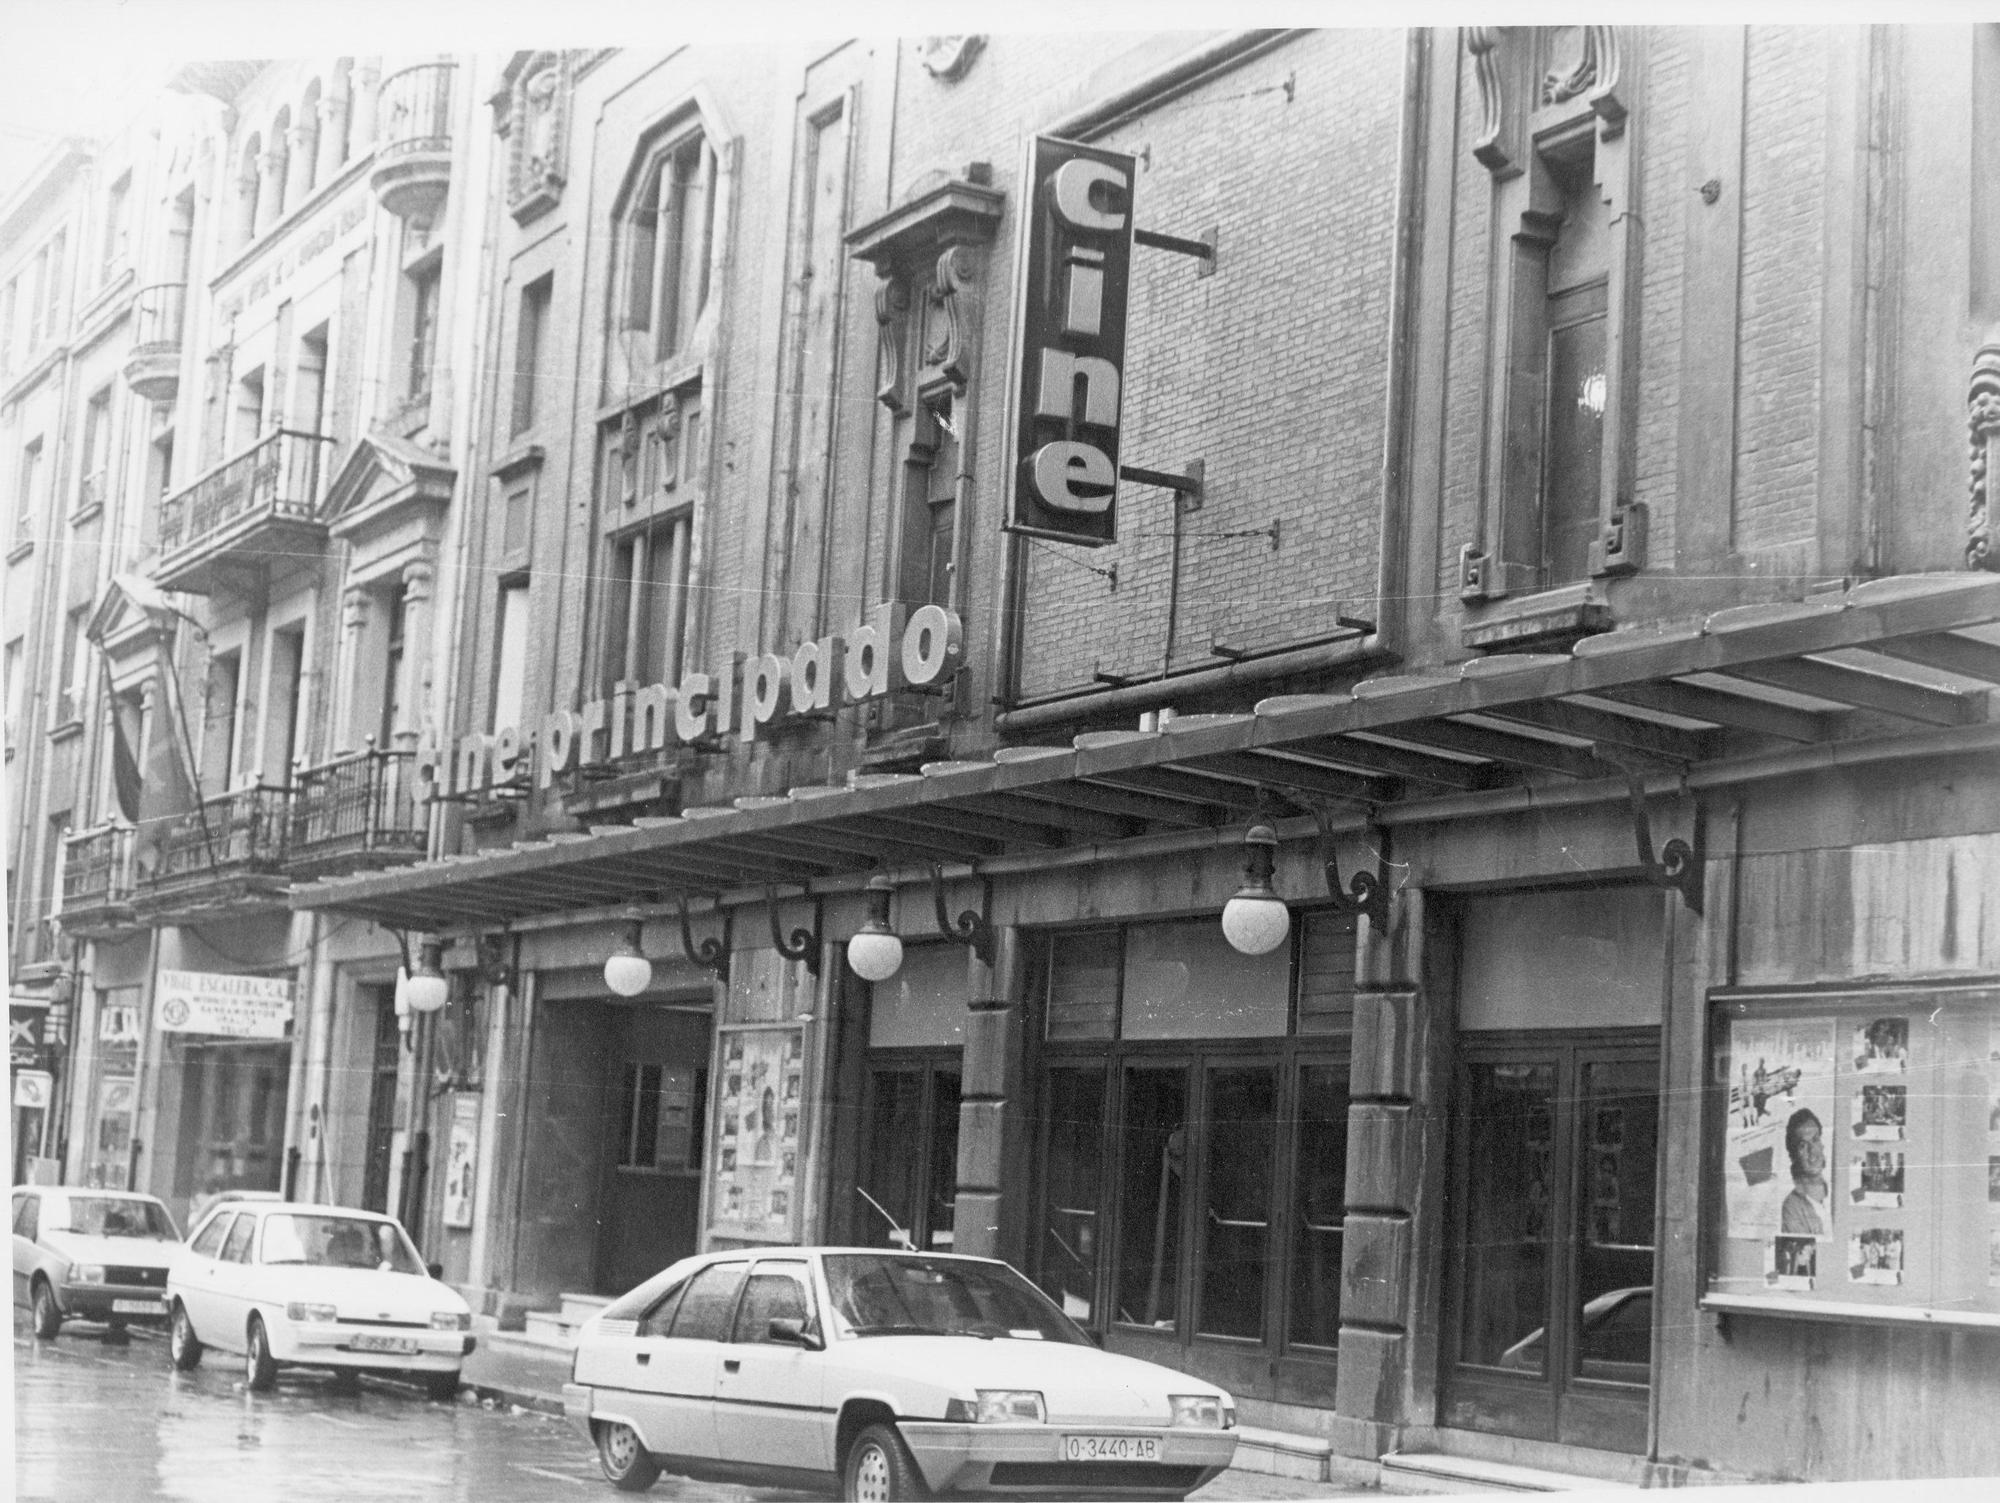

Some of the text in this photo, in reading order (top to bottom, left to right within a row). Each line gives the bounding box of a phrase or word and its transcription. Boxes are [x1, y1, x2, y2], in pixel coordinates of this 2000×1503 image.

[1034, 158, 1128, 512] cine
[411, 602, 956, 800] cine principado
